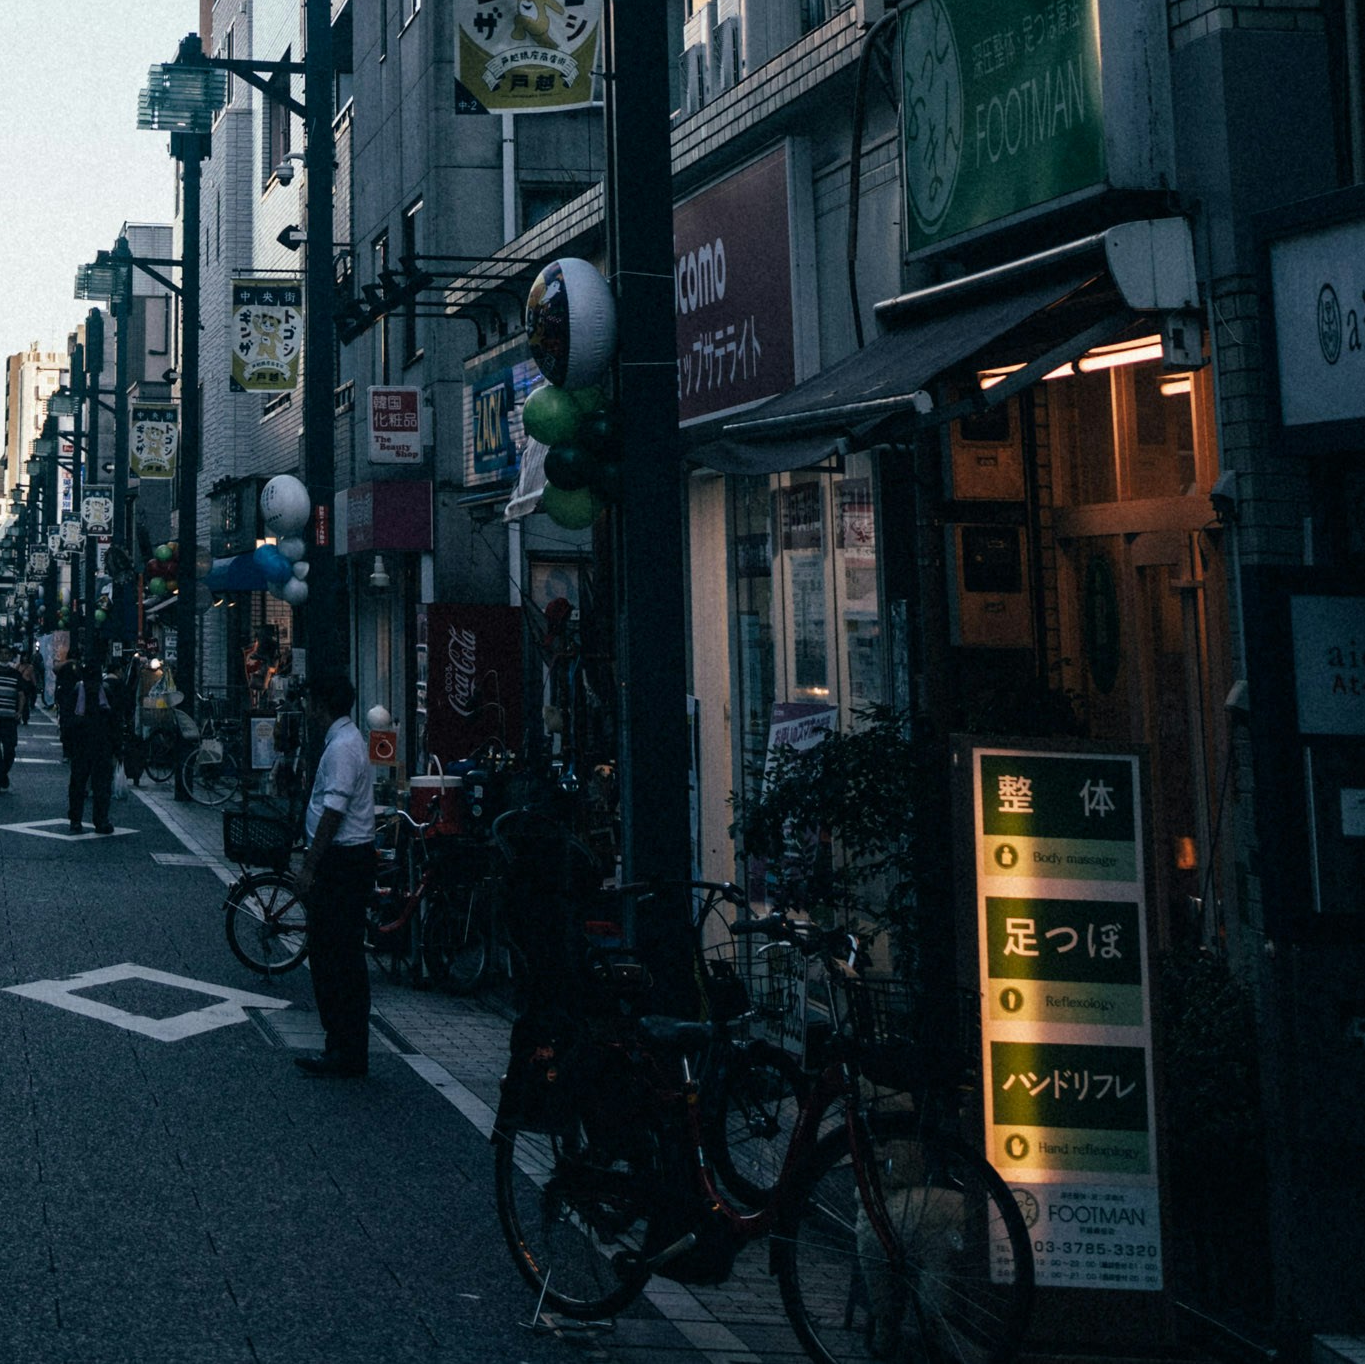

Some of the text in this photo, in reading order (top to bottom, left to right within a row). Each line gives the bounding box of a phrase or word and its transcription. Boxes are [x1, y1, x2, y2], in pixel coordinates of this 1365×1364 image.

[509, 73, 556, 92] 戸越
[975, 53, 1085, 169] FOOTMAN
[240, 290, 296, 303] 中央街
[239, 309, 254, 357] ギンザ
[283, 309, 297, 358] トゴシ
[373, 395, 402, 411] 韓国
[373, 412, 418, 429] 化粧品
[475, 389, 504, 453] ZACK
[374, 435, 392, 444] The
[379, 443, 412, 452] Beauty
[395, 450, 419, 459] Shop
[996, 773, 1116, 818] 整体
[1033, 851, 1117, 868] Body massage
[1003, 917, 1123, 959] 足つぼ
[1046, 995, 1115, 1011] Reflexology
[1002, 1069, 1136, 1102] ハンドリフレ
[1038, 1142, 1069, 1155] Hand
[1048, 1204, 1146, 1226] FOOTMAN
[1034, 1240, 1158, 1258] 03-3785-3320
